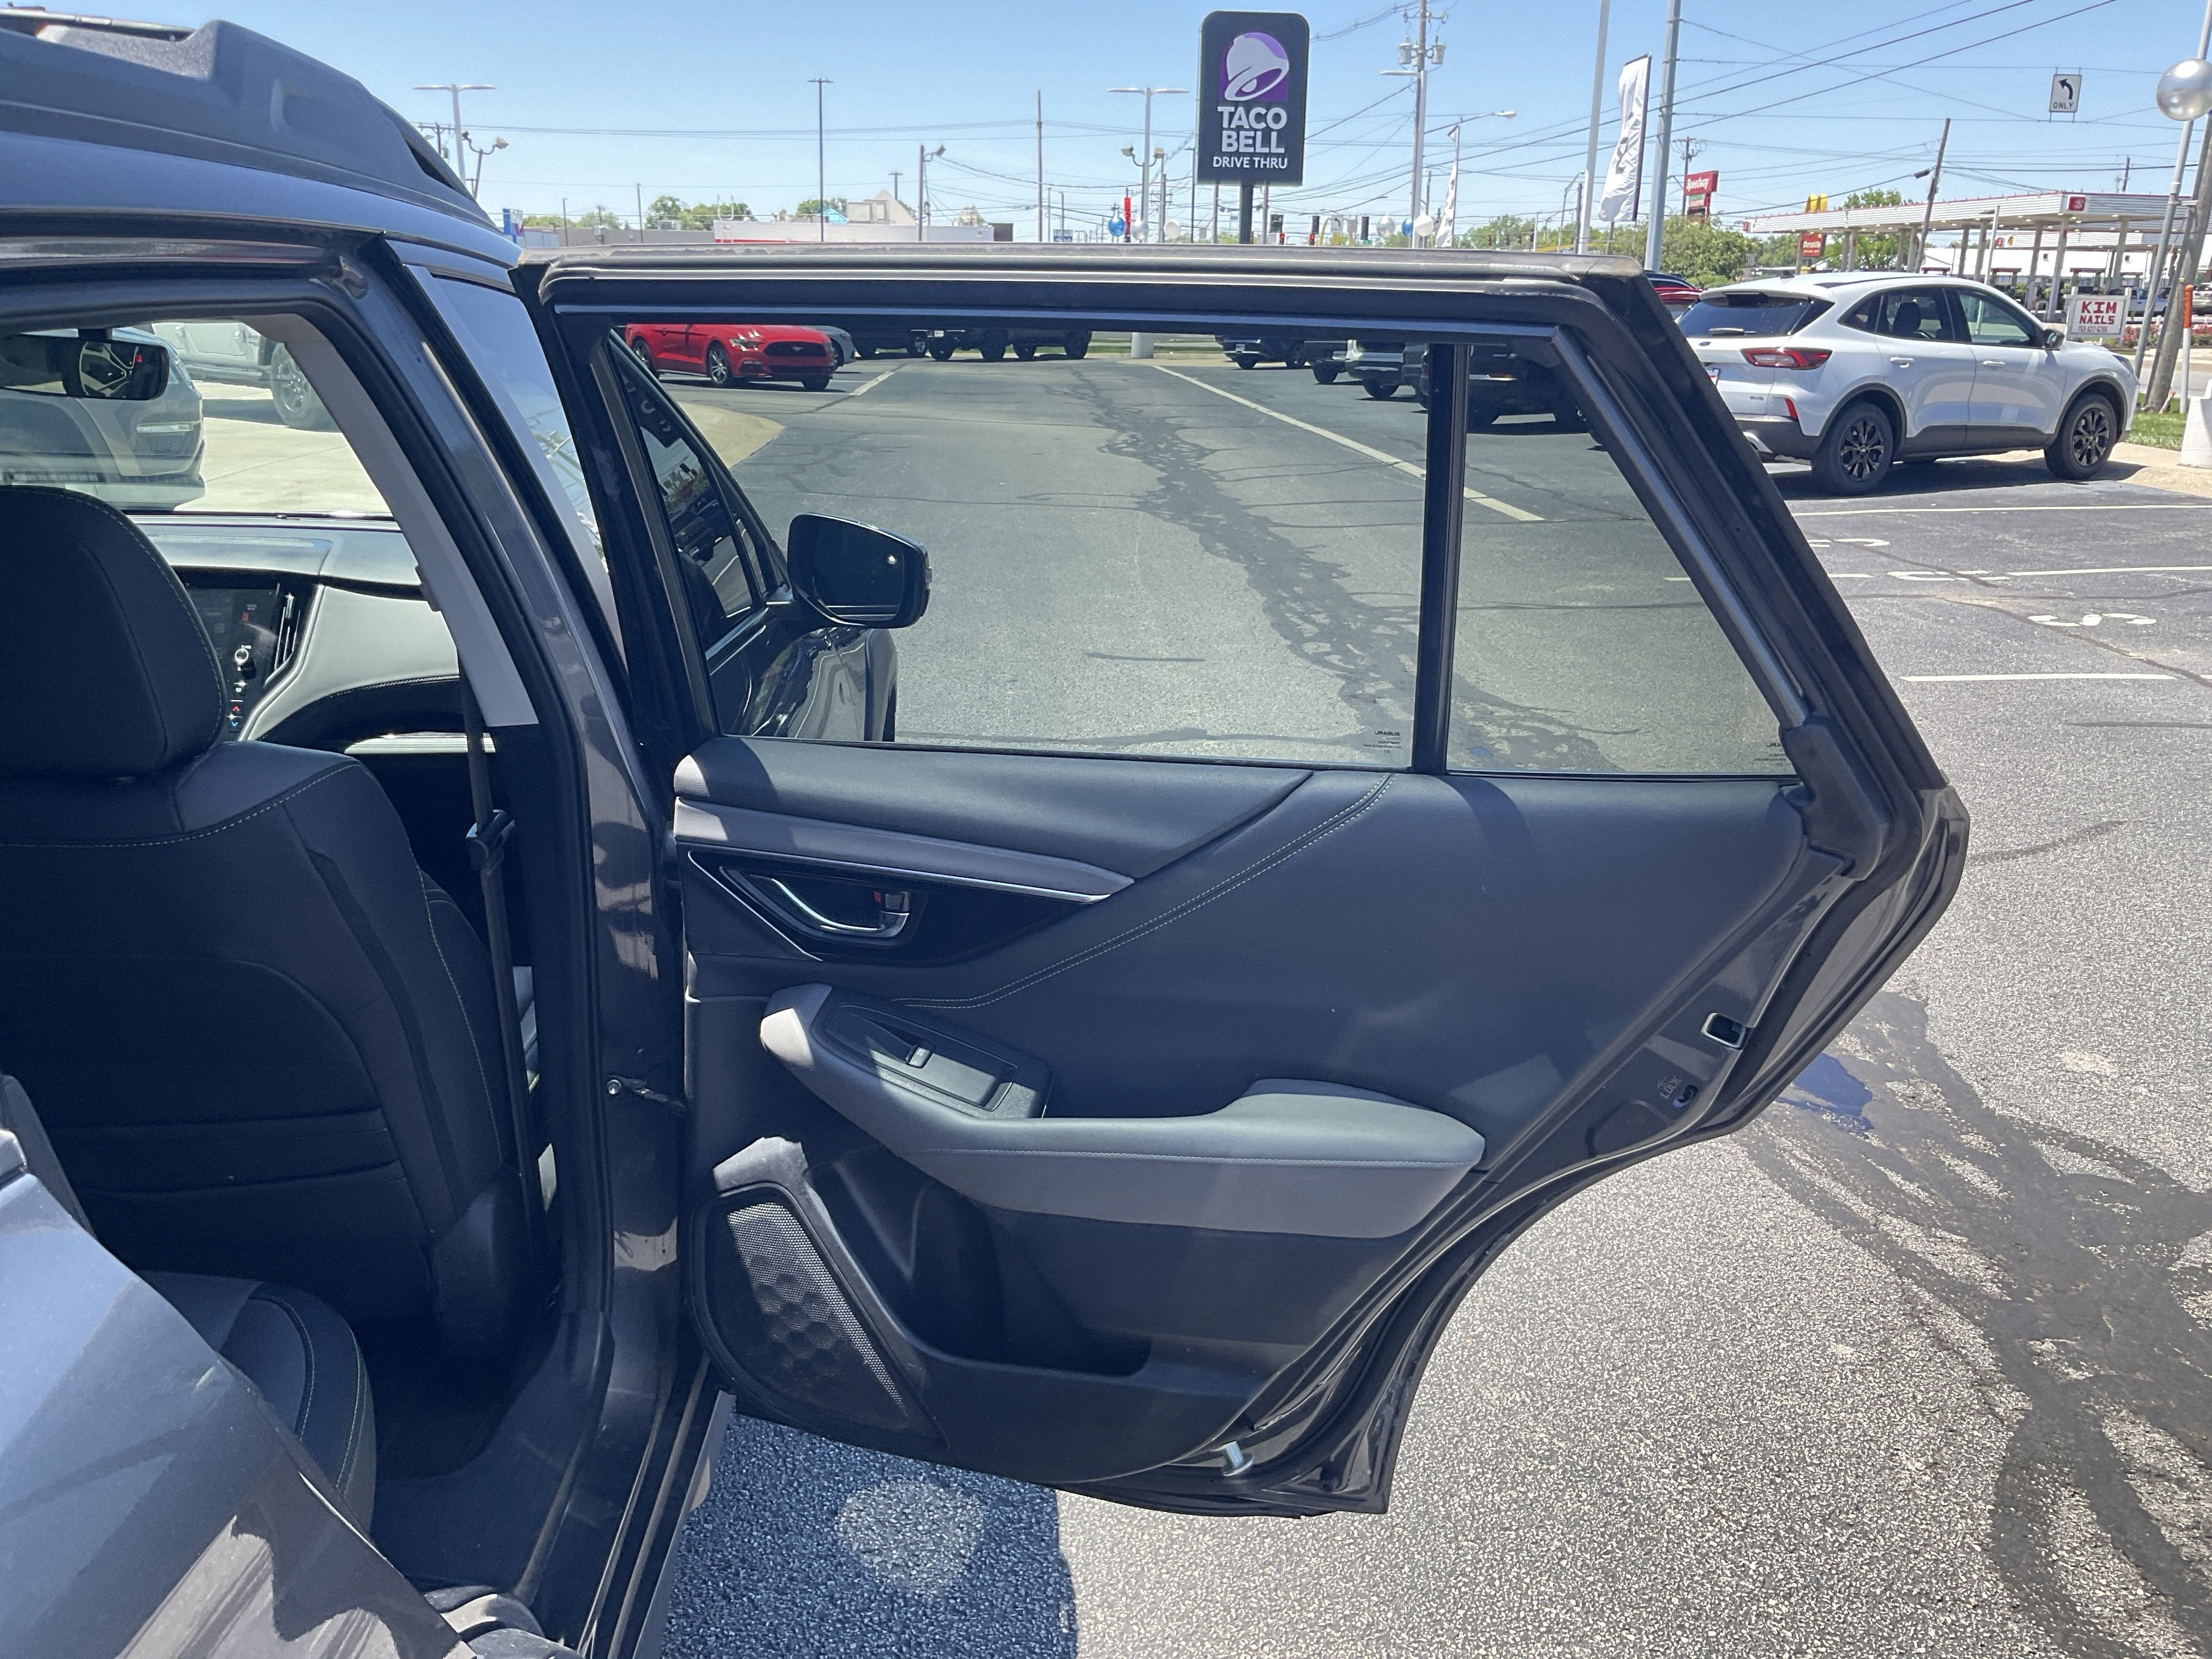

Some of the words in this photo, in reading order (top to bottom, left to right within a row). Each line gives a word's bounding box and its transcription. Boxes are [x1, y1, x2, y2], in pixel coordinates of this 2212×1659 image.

[1217, 106, 1287, 129] TACO
[1222, 131, 1285, 153] BELL
[1213, 156, 1250, 168] DRIVE
[1253, 157, 1288, 169] THRU
[2081, 301, 2117, 314] KIM
[2079, 315, 2115, 325] NAILS
[1660, 1076, 1682, 1099] LOCK
